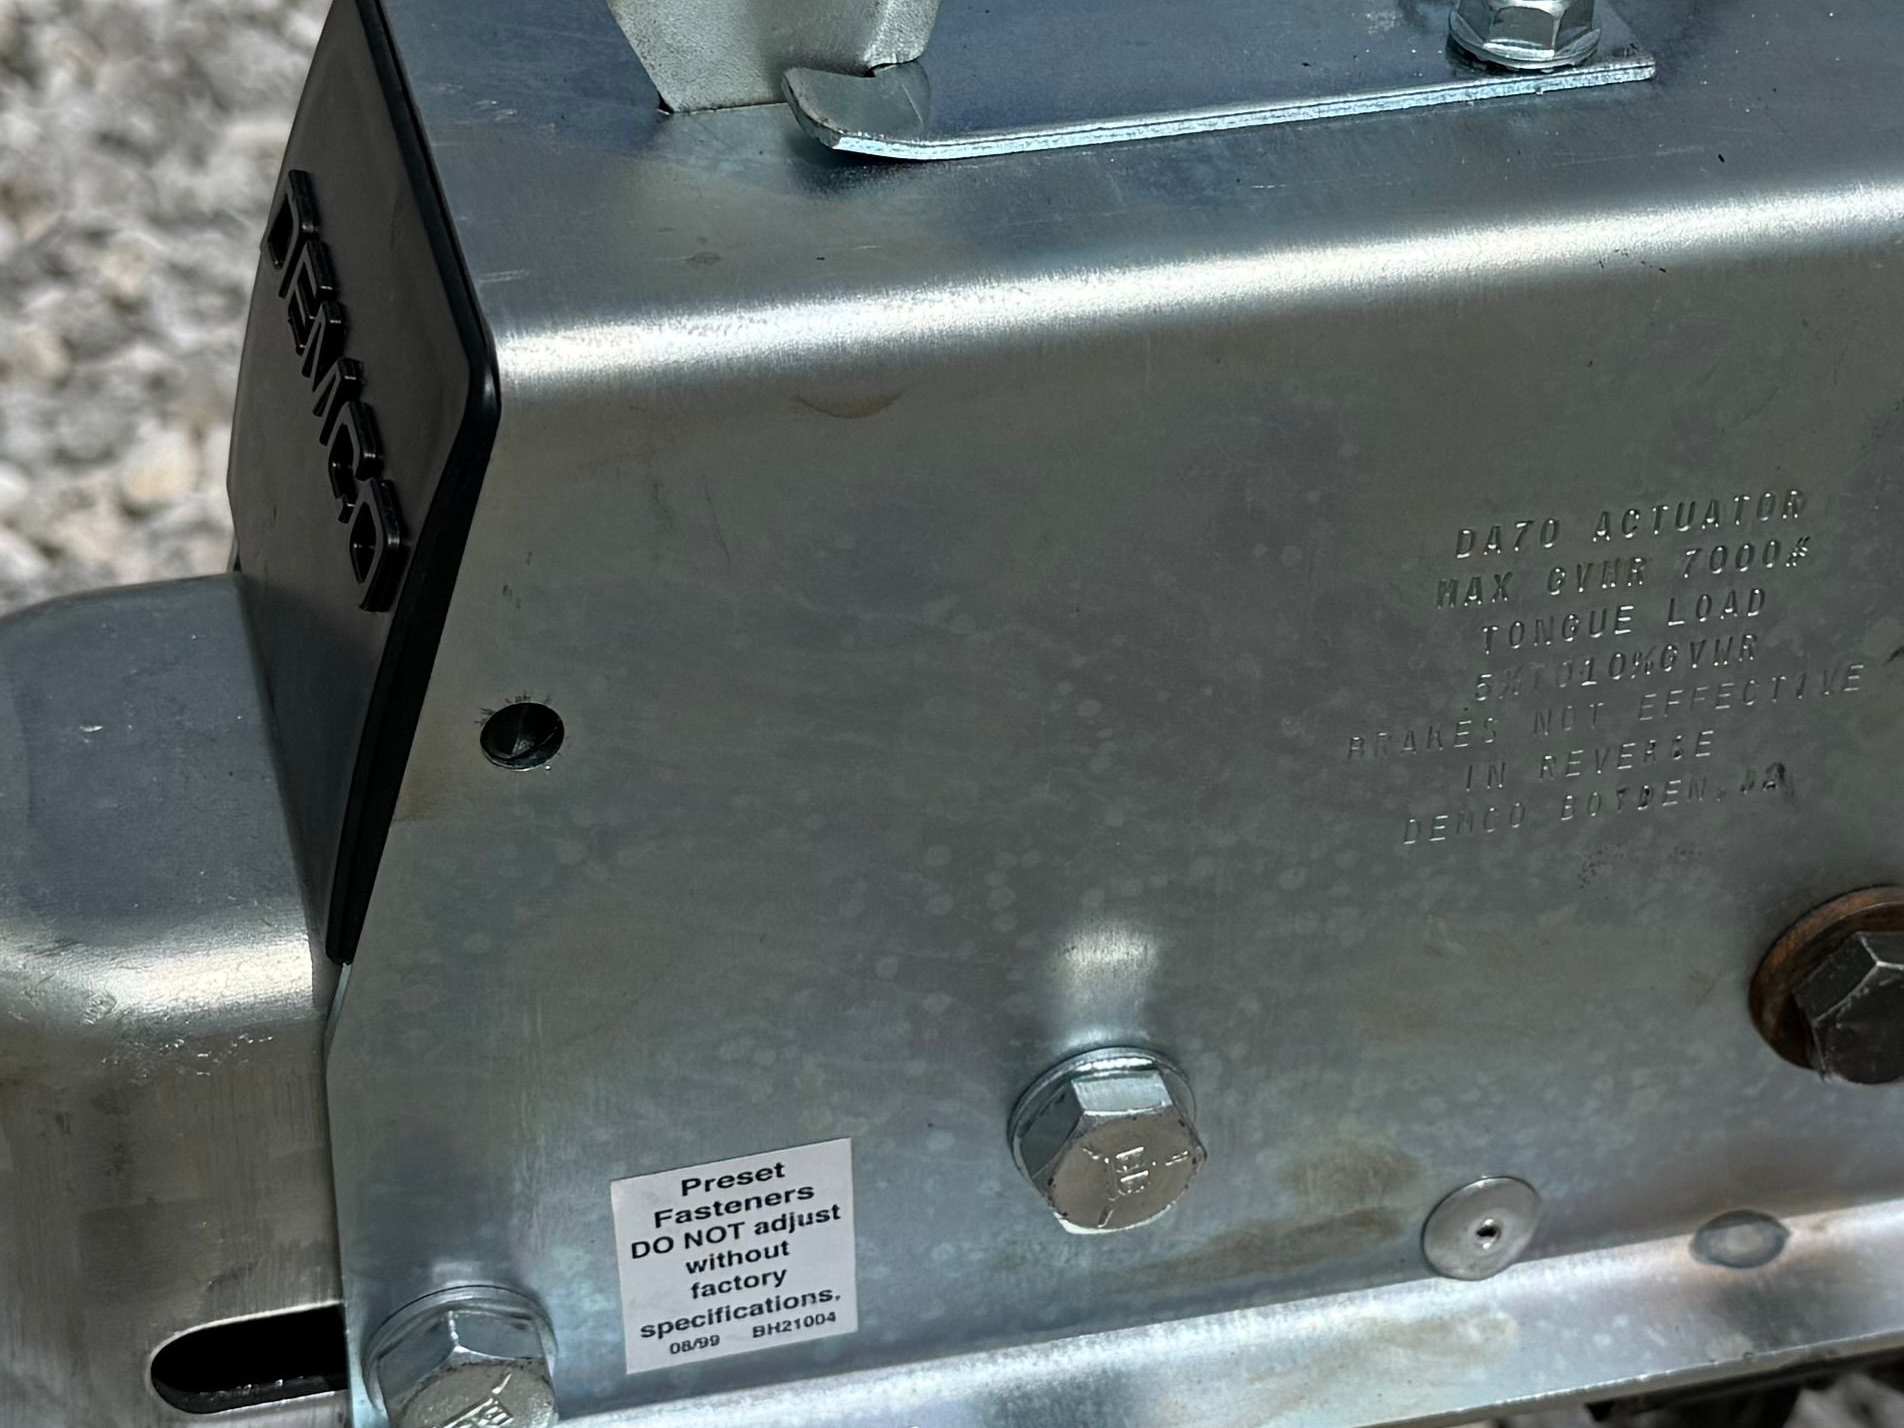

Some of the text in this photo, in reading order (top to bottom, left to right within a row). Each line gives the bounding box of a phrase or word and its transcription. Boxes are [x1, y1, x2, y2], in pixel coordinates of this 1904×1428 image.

[1455, 488, 1809, 560] DA70 ACTUATOR
[1436, 570, 1514, 610] MAX
[1546, 555, 1649, 596] GVWR
[1482, 586, 1767, 655] TONGUE LOAD
[1348, 663, 1865, 760] BRAKES NOT EFFECTIVE
[1465, 729, 1714, 792] IN REVERSE
[1403, 801, 1526, 845] DEMCO
[653, 1184, 815, 1228] Fasteners
[680, 1162, 786, 1197] Preset
[630, 1203, 841, 1260] DO NOT adjust
[686, 1240, 790, 1274] without
[690, 1269, 788, 1300] factory
[640, 1287, 842, 1340] specifications.
[669, 1311, 837, 1355] 08/99 BH21004
